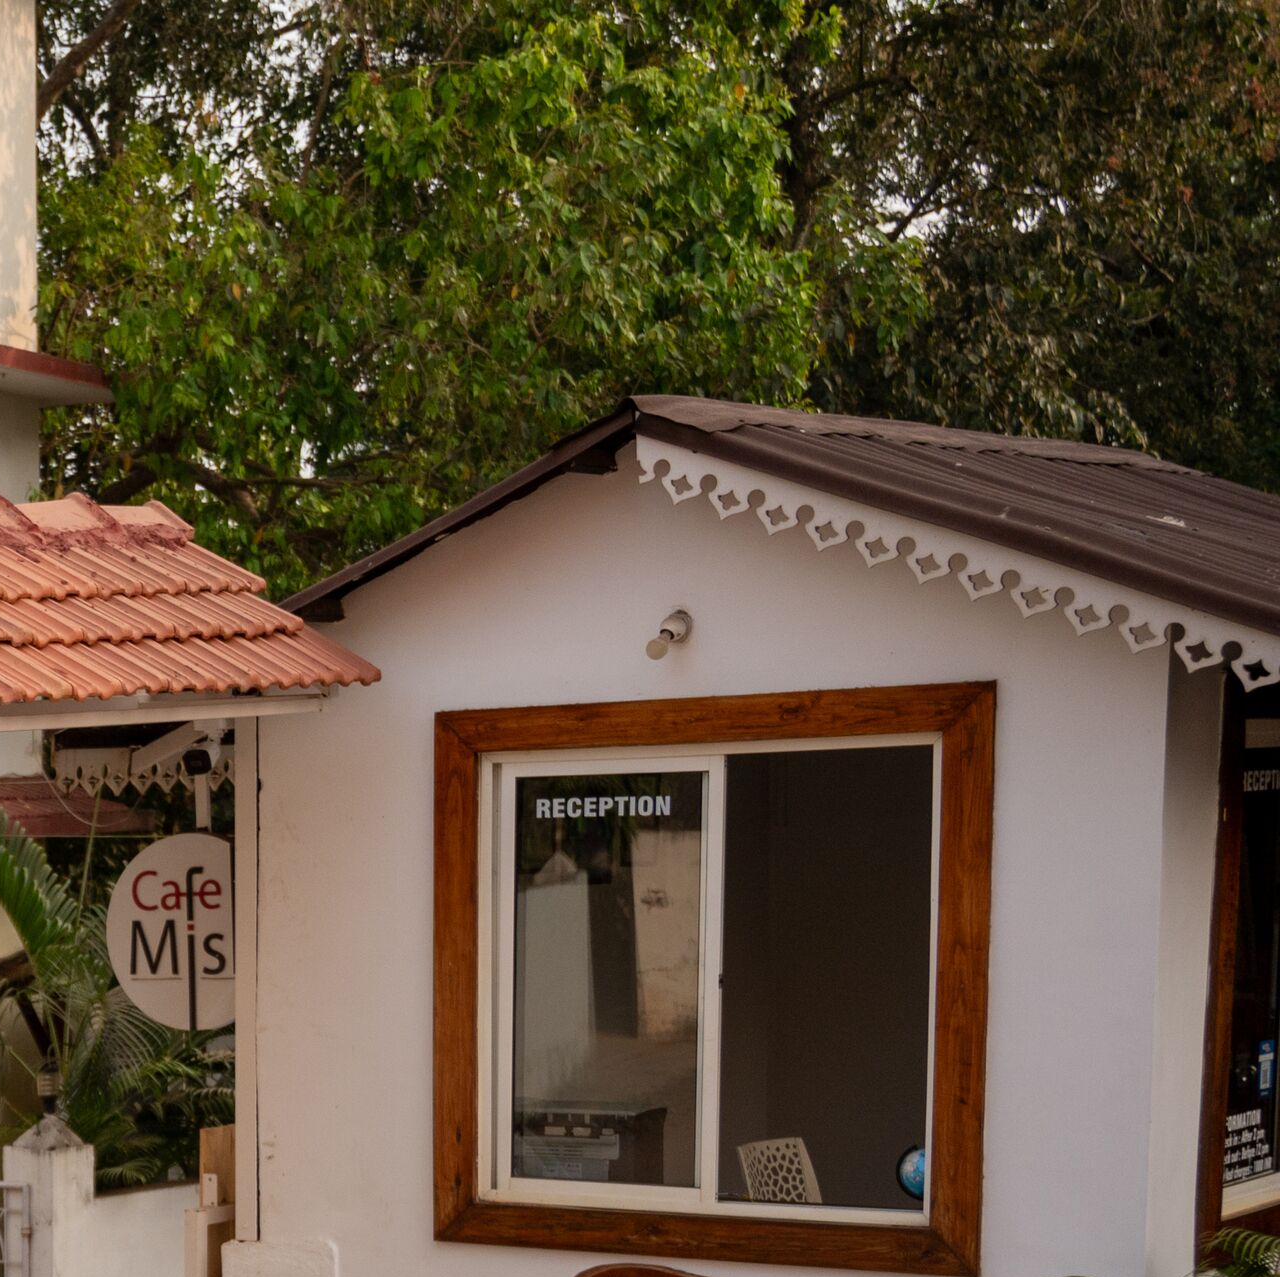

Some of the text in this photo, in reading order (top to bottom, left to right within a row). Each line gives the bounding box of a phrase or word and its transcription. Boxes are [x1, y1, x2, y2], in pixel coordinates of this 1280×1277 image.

[536, 795, 671, 819] RECEPTION
[131, 866, 222, 921] Cafe
[130, 919, 235, 1030] Mis
